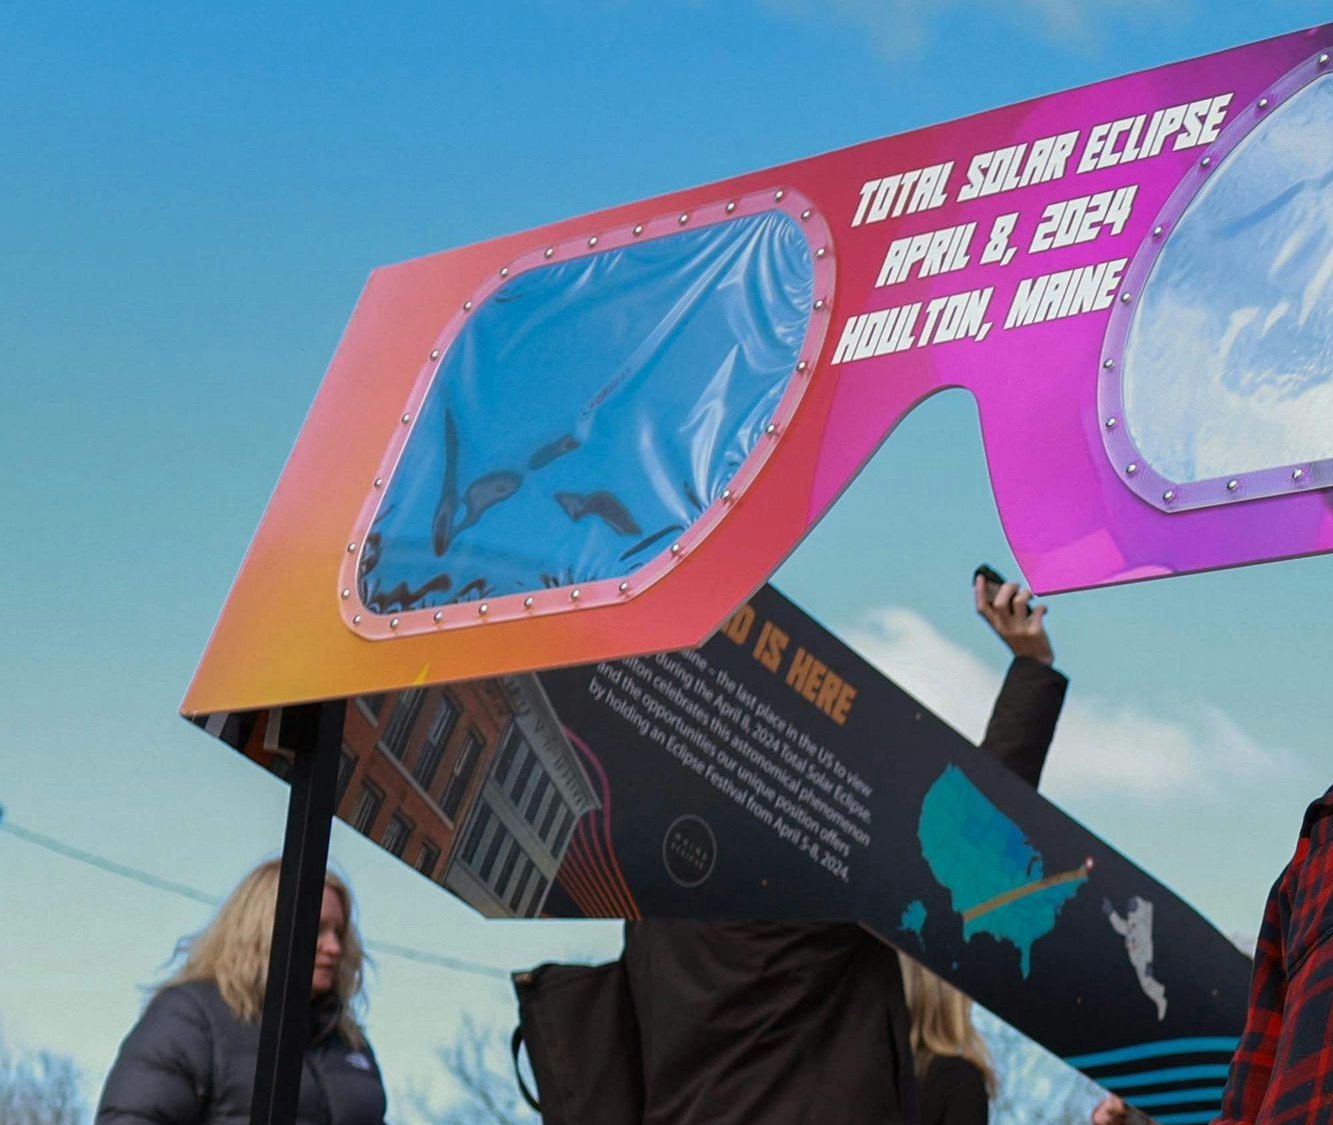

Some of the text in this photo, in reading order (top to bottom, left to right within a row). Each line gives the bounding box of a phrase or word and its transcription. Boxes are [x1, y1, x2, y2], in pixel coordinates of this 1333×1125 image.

[851, 92, 1234, 227] TOTAL SOLAR ECLIPSE
[875, 185, 1138, 288] APRIL 8, 2024
[831, 258, 1127, 365] HOULTON, MAINE
[656, 653, 693, 690] during
[693, 678, 713, 702] the
[712, 694, 742, 722] April
[751, 722, 780, 752] 2024
[780, 742, 807, 772] Total
[805, 764, 834, 792] Solar
[715, 670, 736, 693] the
[735, 683, 756, 709] last
[754, 703, 786, 732] place
[785, 723, 798, 741] in
[797, 733, 817, 756] the
[817, 746, 834, 768] US
[832, 760, 846, 778] to
[846, 771, 872, 796] view
[752, 620, 790, 673] IS
[785, 646, 857, 726] HERE
[588, 676, 605, 700] by
[605, 689, 650, 734] holding
[649, 726, 666, 744] an
[665, 735, 704, 773] Eclipse
[704, 764, 747, 803] Festival
[745, 794, 773, 824] from
[772, 816, 801, 843] April
[597, 662, 849, 856] and the opportunities our unique position offers
[652, 676, 708, 725] celebrates
[709, 717, 730, 741] this
[730, 735, 800, 792] astronomical
[798, 787, 869, 845] phenomenon
